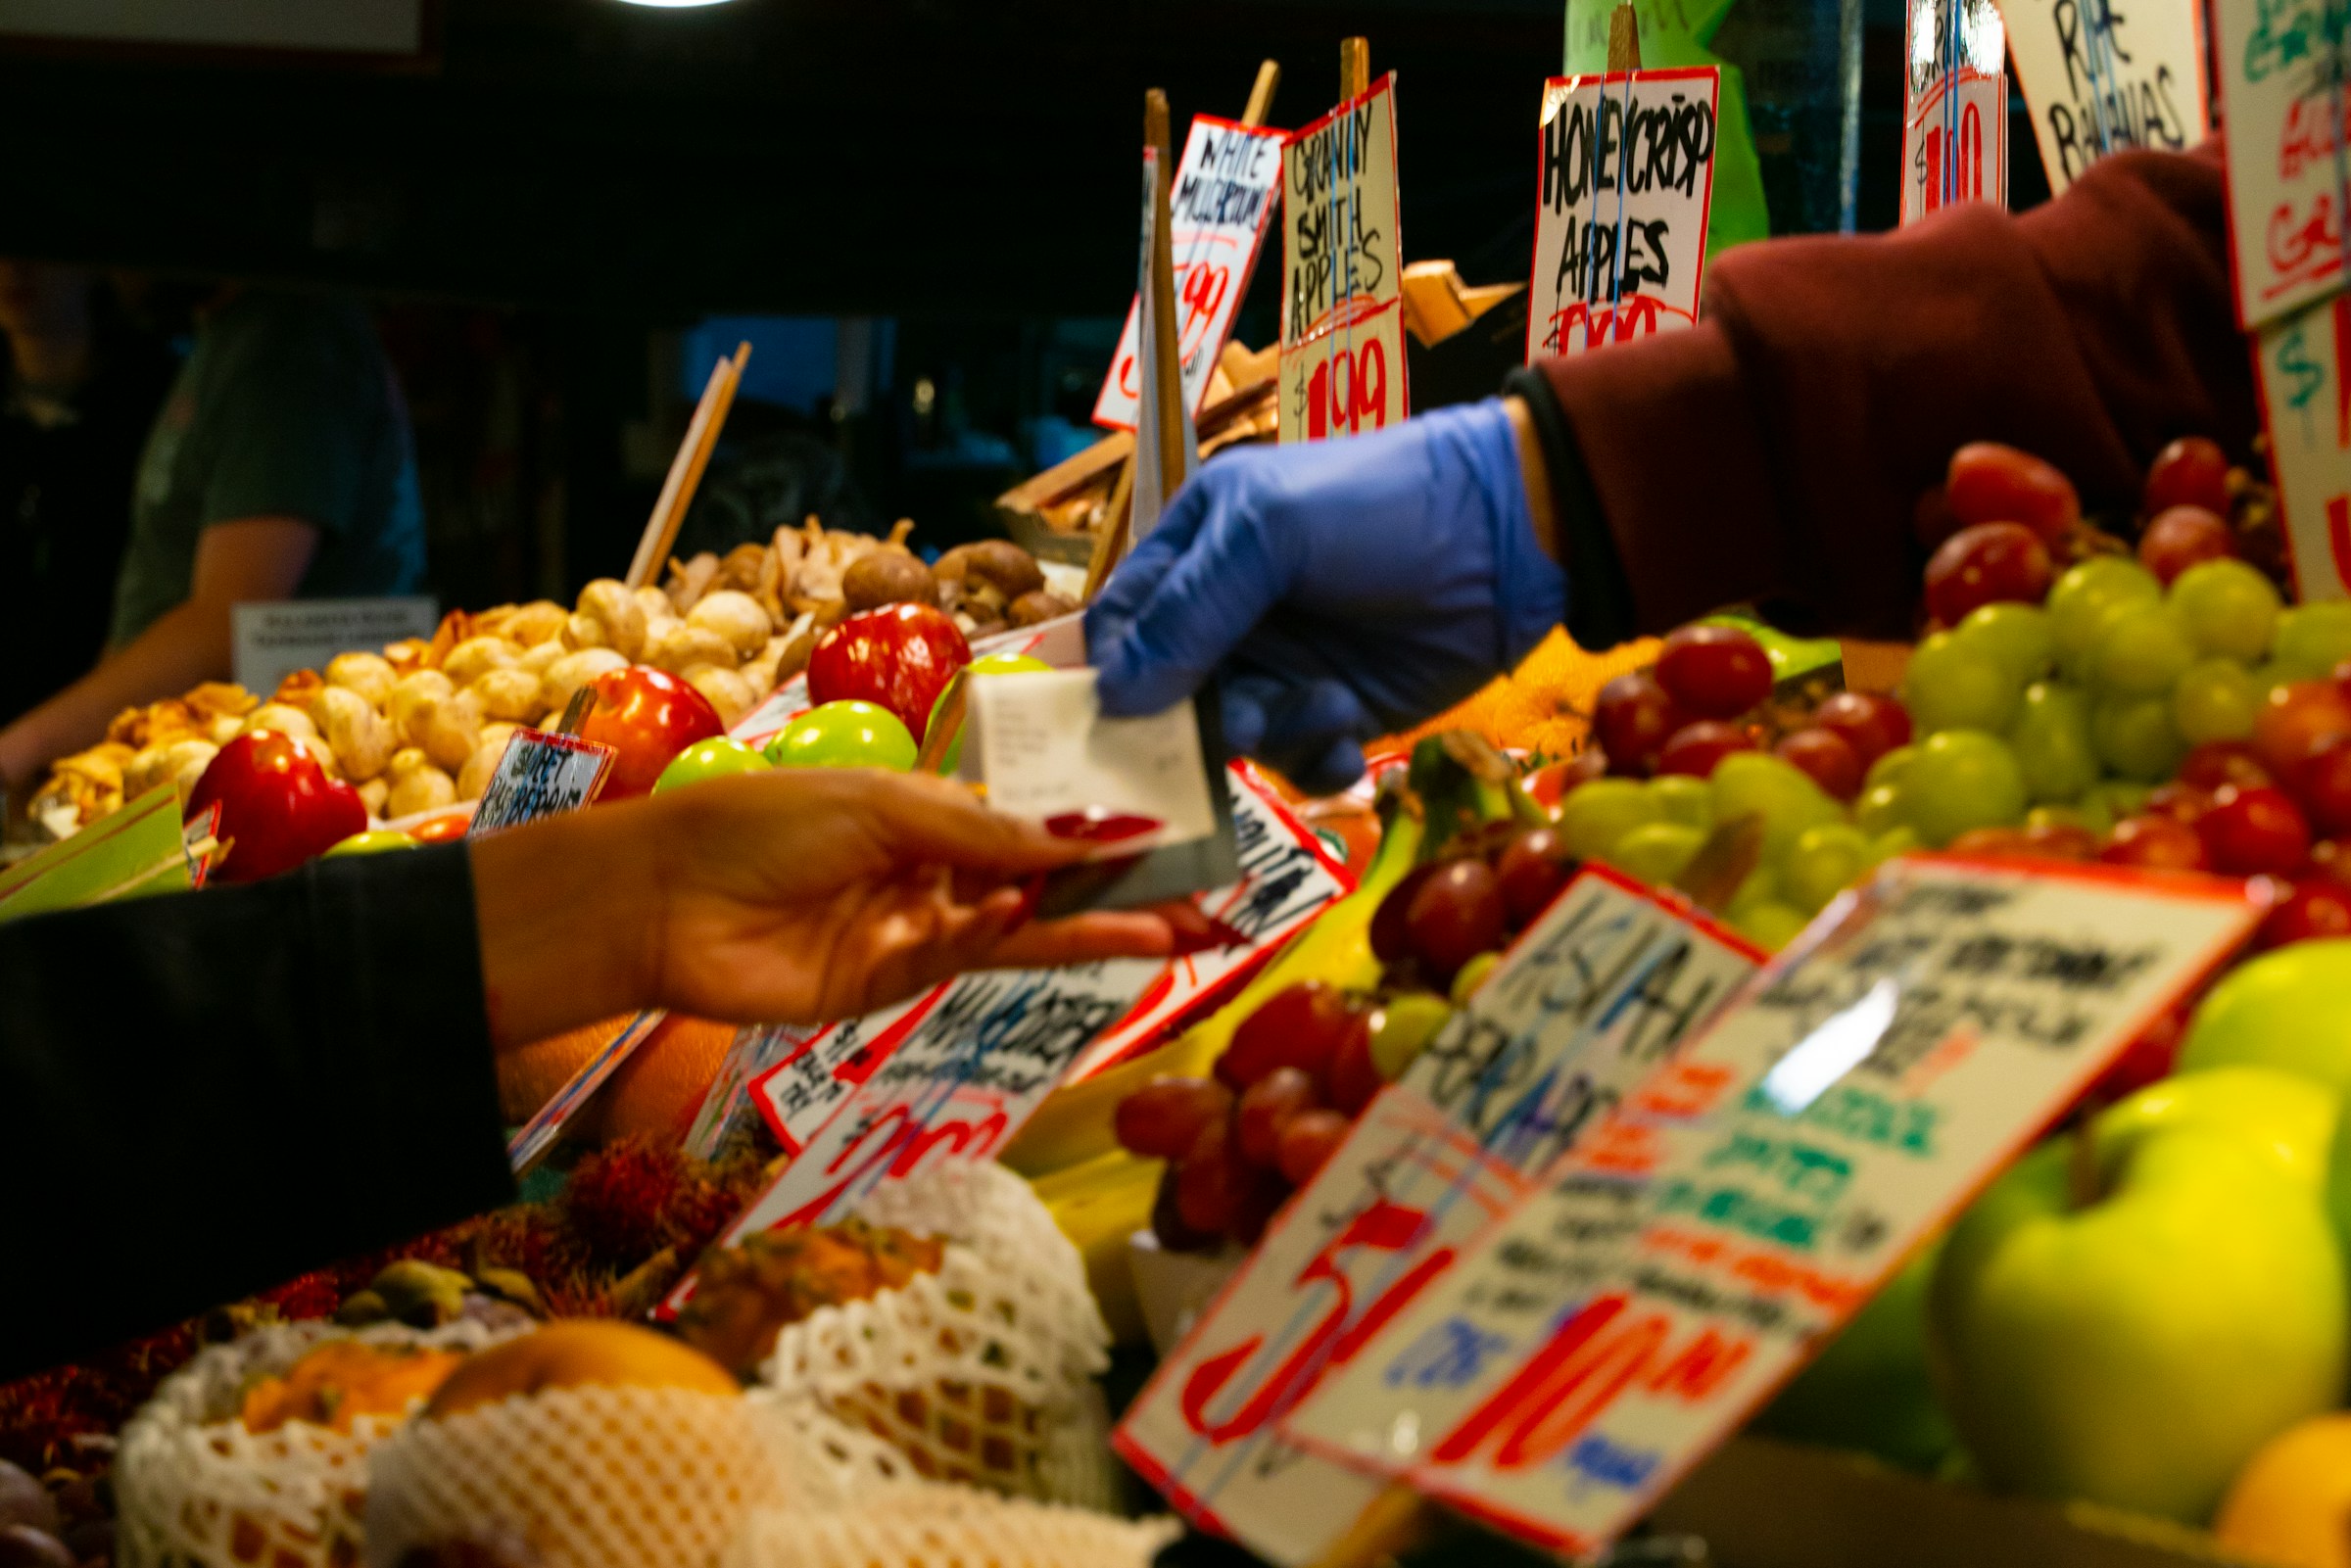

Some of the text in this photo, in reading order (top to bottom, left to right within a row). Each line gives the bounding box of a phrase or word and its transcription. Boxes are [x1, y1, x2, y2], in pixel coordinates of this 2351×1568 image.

[1292, 101, 1373, 204] GRANNY
[1296, 186, 1363, 261] SMITH
[1554, 213, 1670, 306] APPLES
[1289, 227, 1383, 343] APPLES
